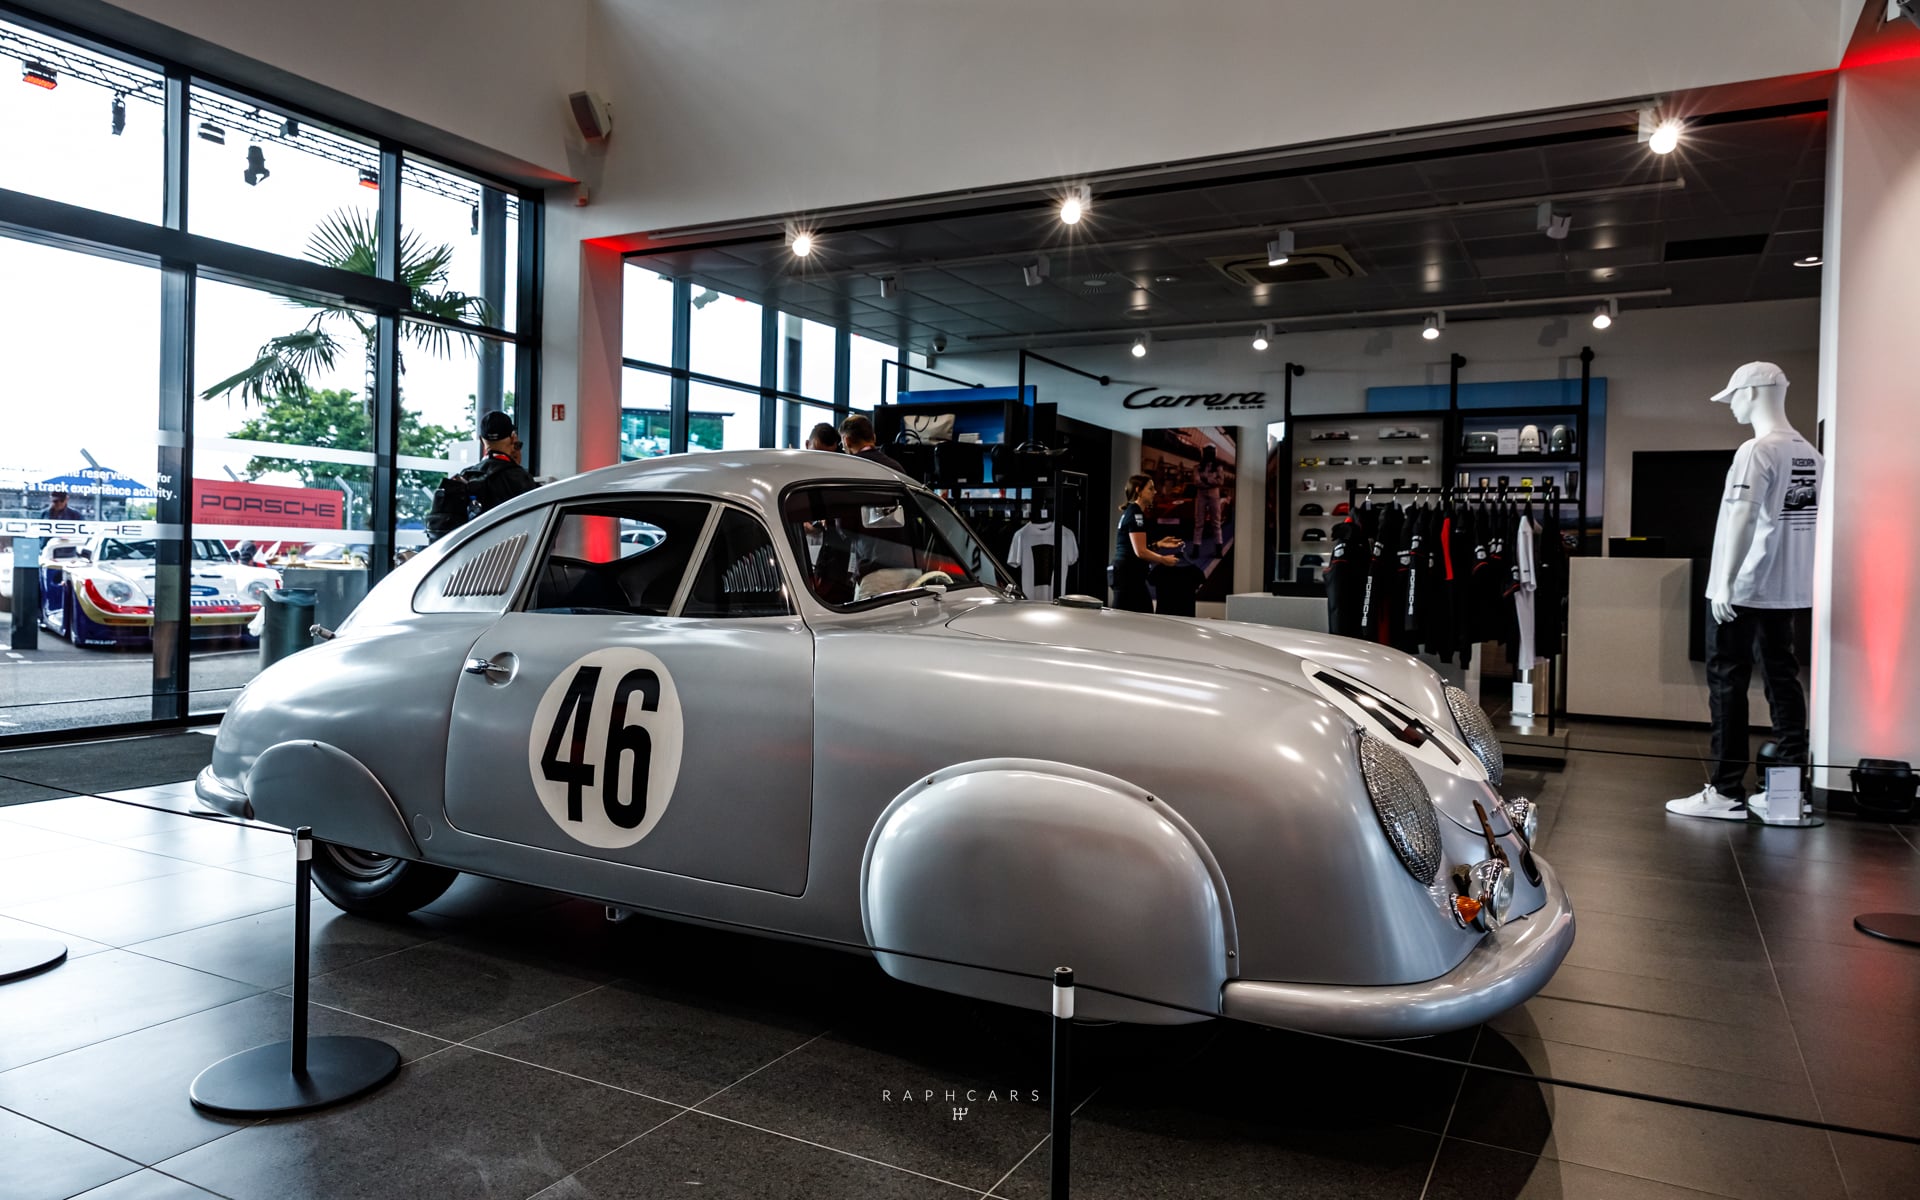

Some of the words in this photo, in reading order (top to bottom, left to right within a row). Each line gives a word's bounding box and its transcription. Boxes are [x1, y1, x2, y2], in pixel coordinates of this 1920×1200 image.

[1123, 387, 1266, 409] Carrera
[39, 481, 69, 493] track
[71, 483, 131, 497] experience
[157, 472, 172, 484] for
[201, 494, 336, 518] PORSCHE
[0, 521, 142, 536] ORSCHE
[1361, 575, 1373, 627] PORSCHE
[1407, 568, 1416, 616] PORSCHE
[541, 665, 661, 830] 46
